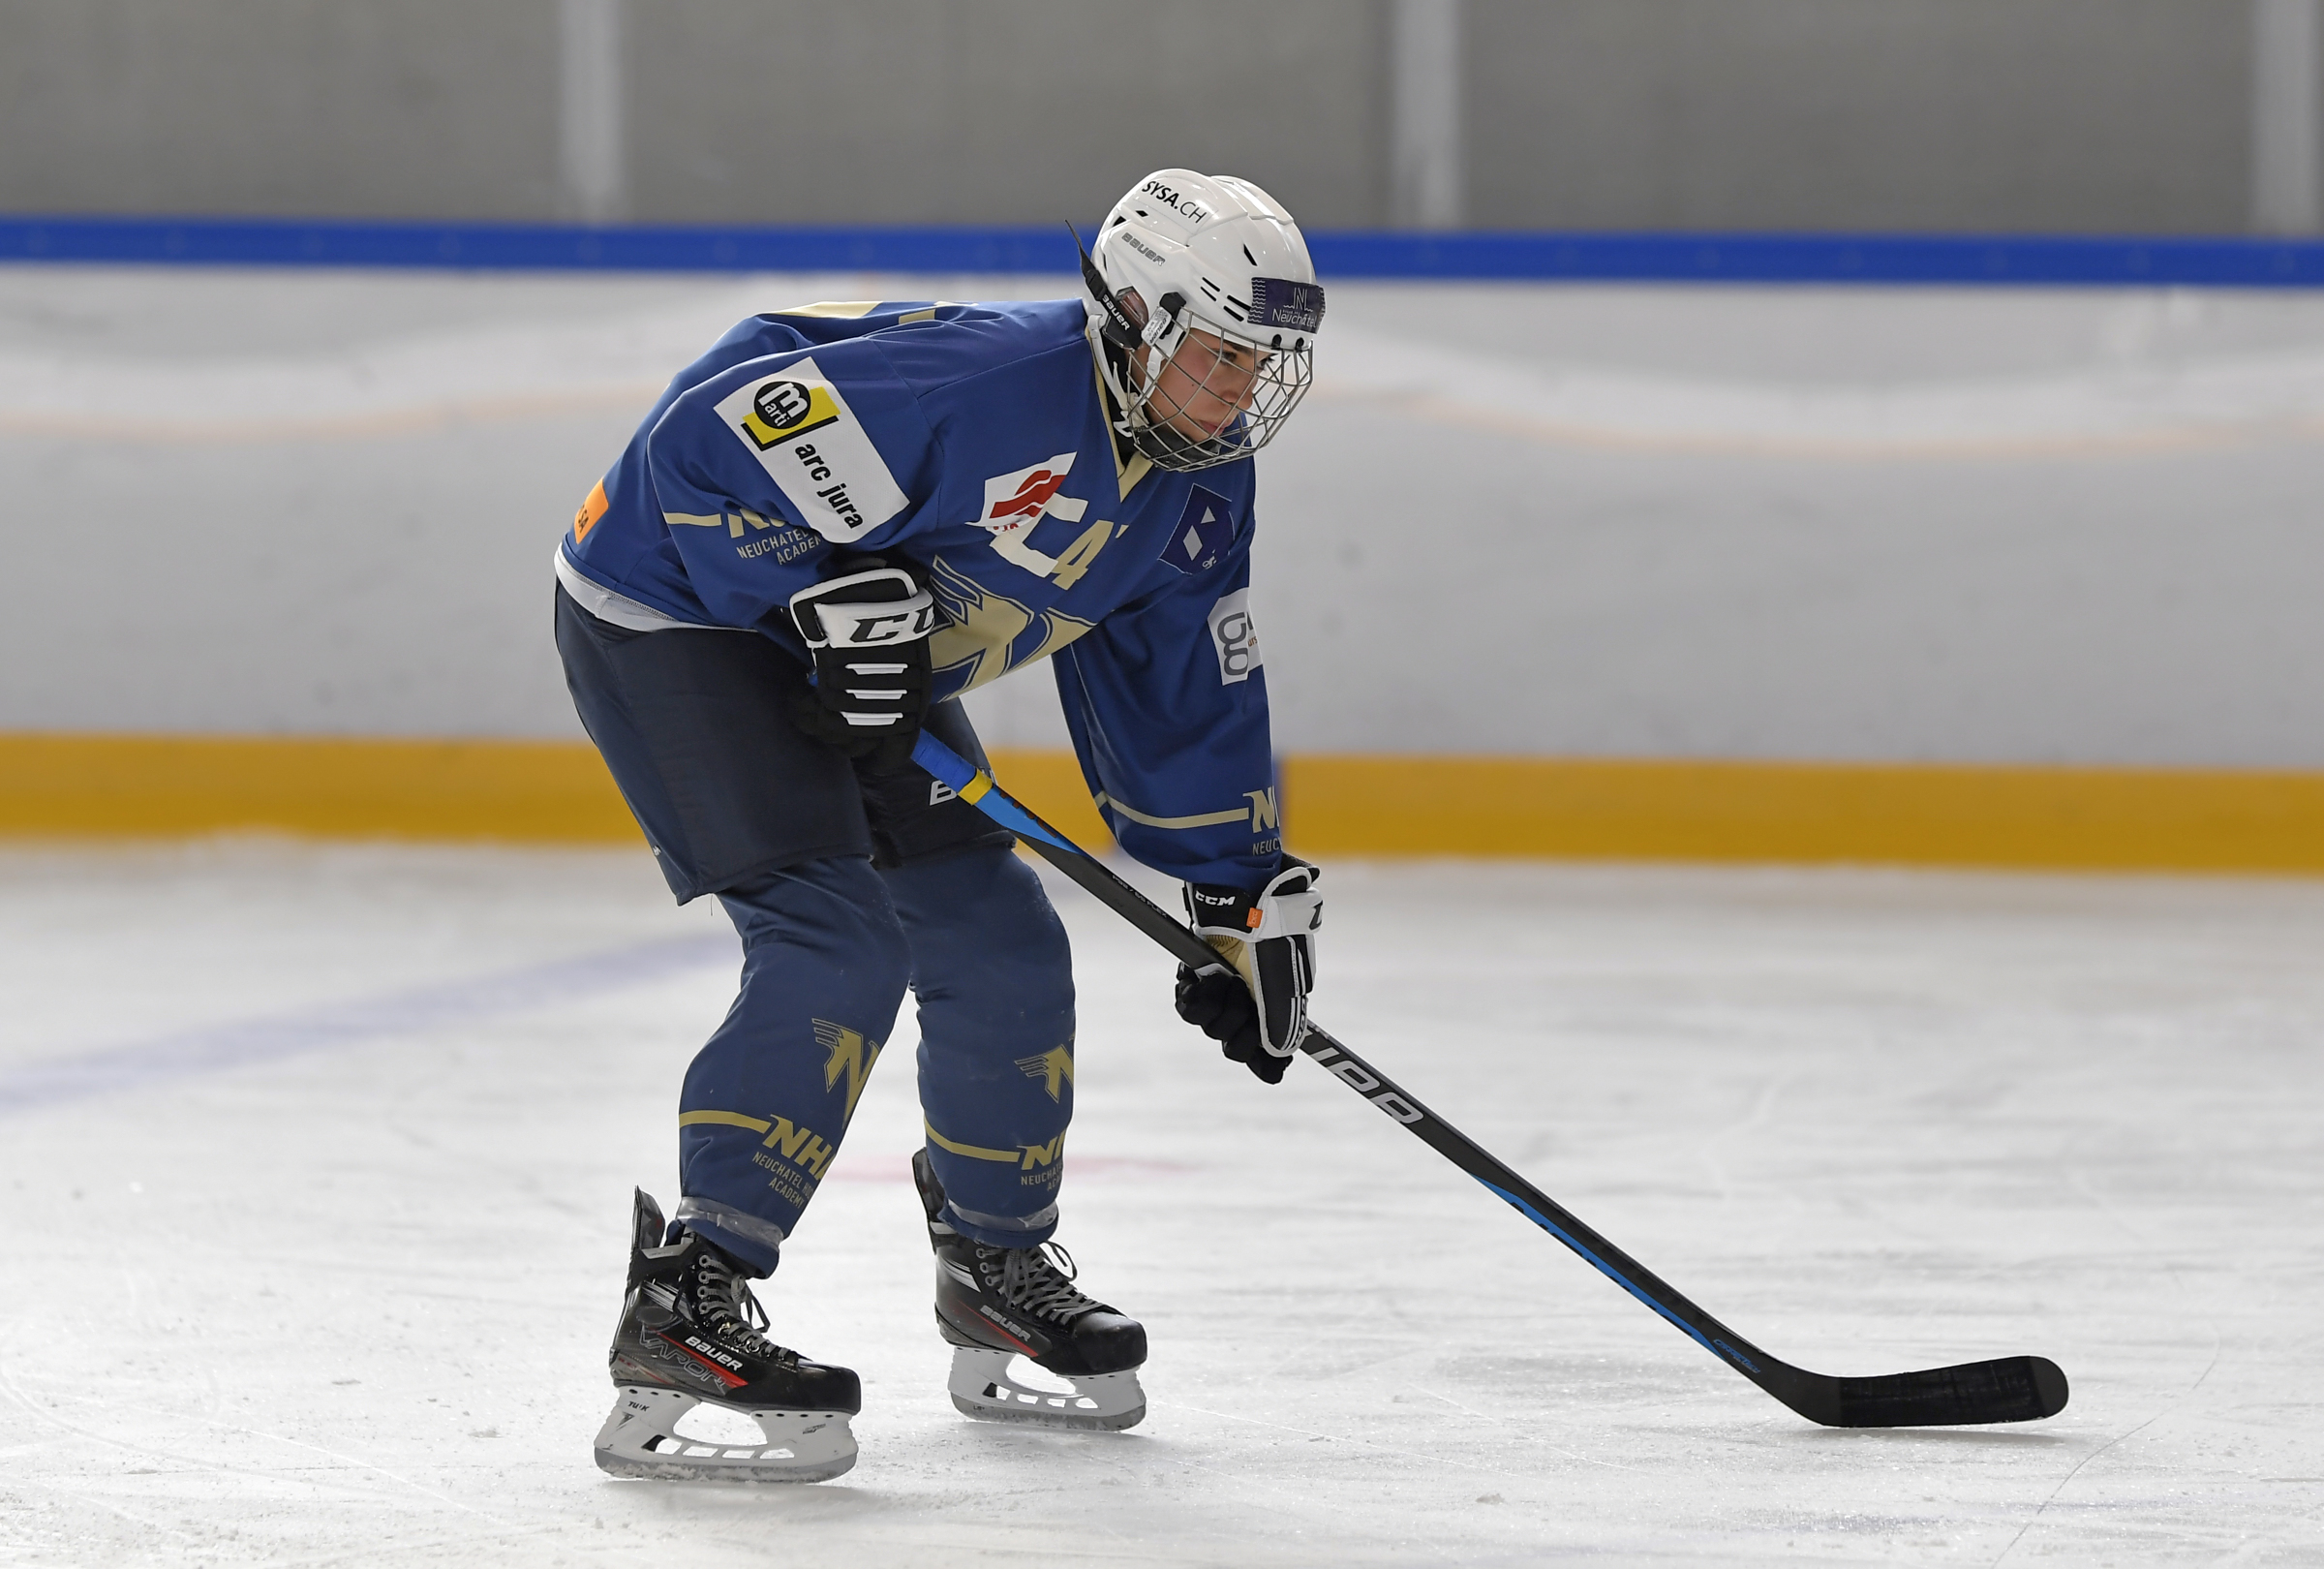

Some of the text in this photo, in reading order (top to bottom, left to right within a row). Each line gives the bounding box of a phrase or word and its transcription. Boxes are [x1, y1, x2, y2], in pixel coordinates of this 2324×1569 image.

[1141, 180, 1208, 224] SYSA.CH
[794, 443, 864, 530] arc jura
[1052, 519, 1129, 591] 4
[1195, 890, 1236, 907] CCM
[751, 1152, 804, 1189] NEUCHATEL
[768, 1177, 805, 1209] ACADEMY
[684, 1336, 744, 1371] BAUER
